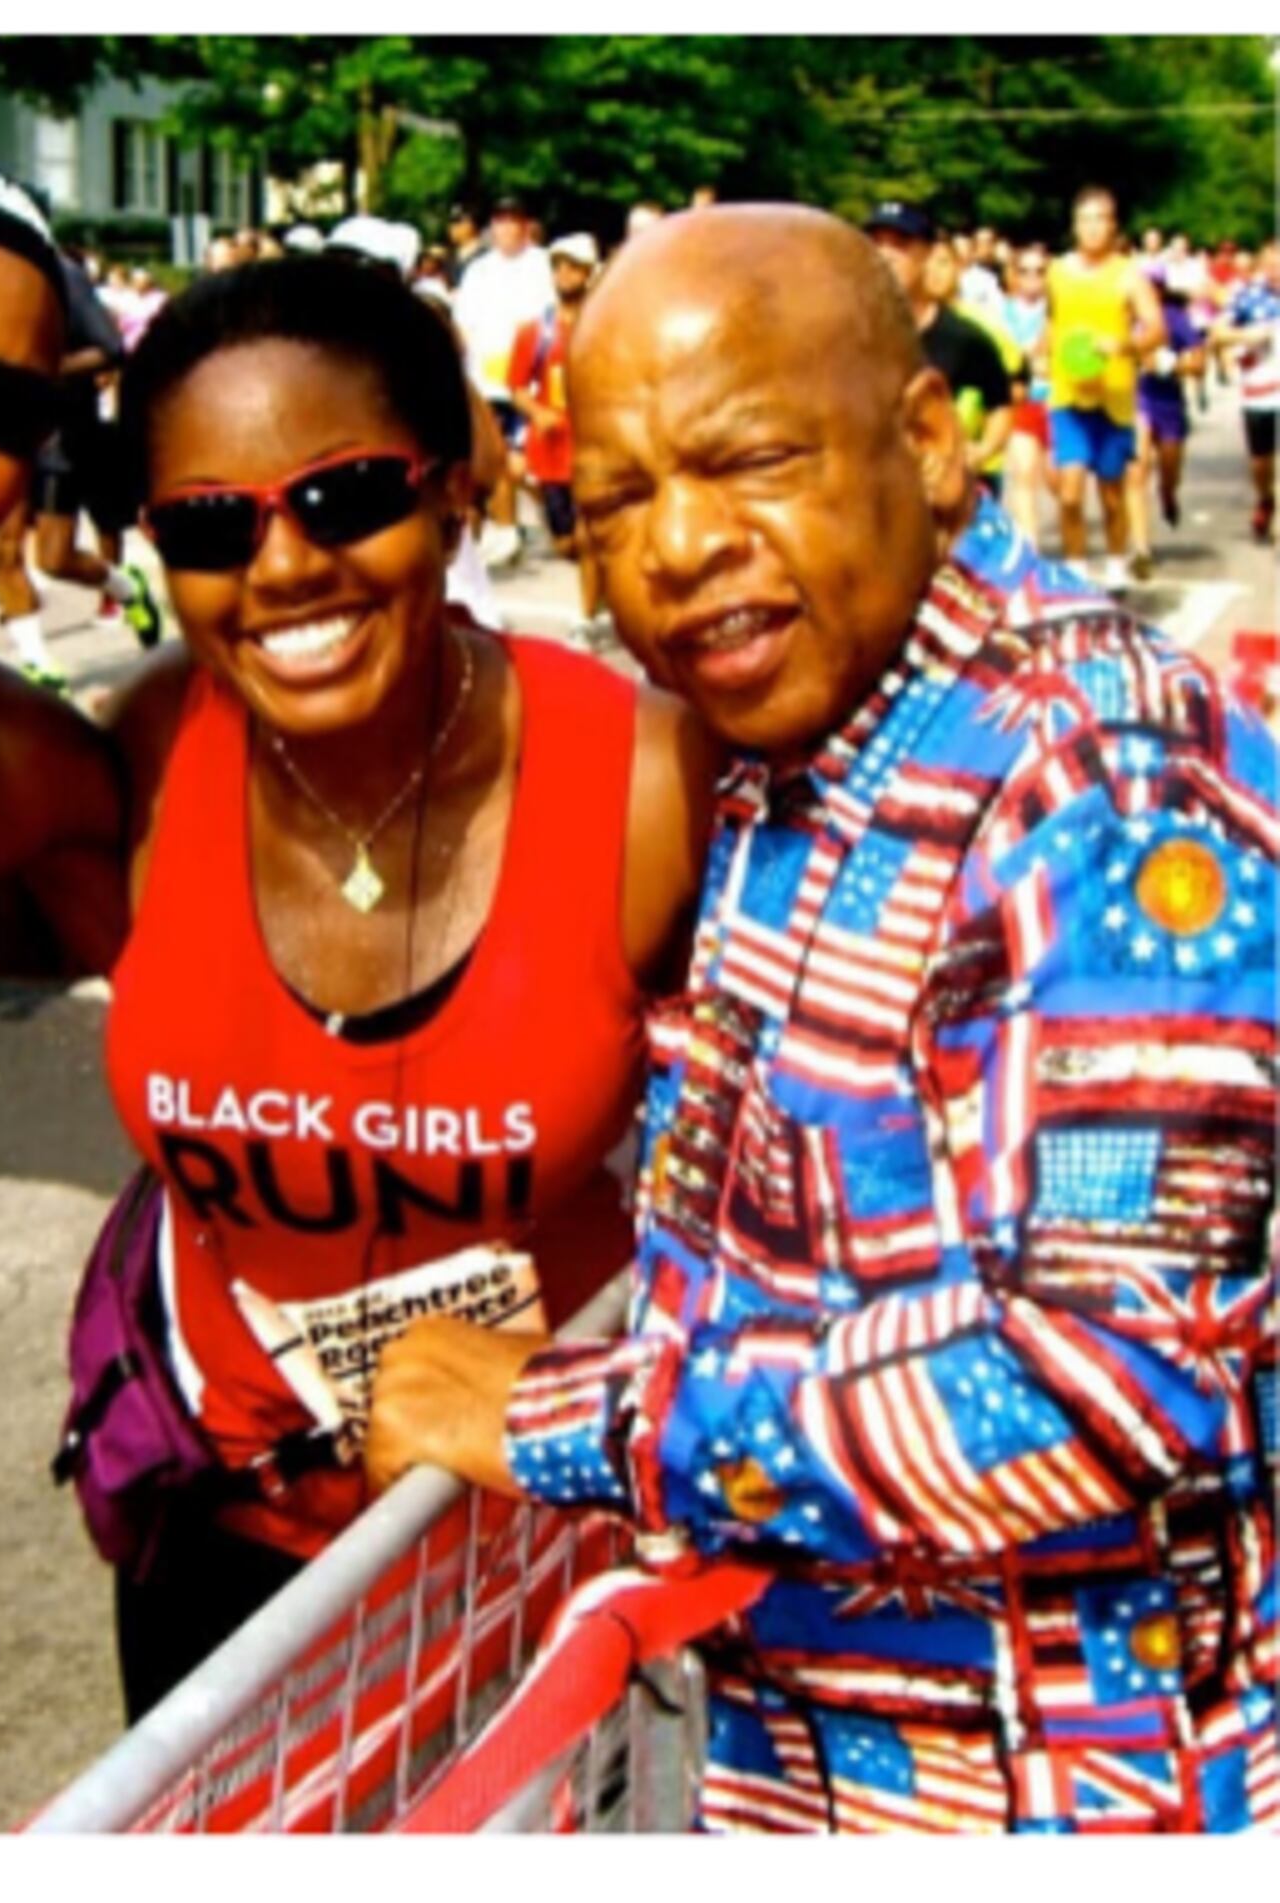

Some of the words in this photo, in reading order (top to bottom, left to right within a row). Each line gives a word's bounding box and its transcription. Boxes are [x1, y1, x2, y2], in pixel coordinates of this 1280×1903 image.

[146, 1072, 336, 1142] BLACK
[352, 1101, 538, 1156] GIRLS
[156, 1130, 534, 1237] RUN!
[308, 1263, 512, 1346] Peachtree
